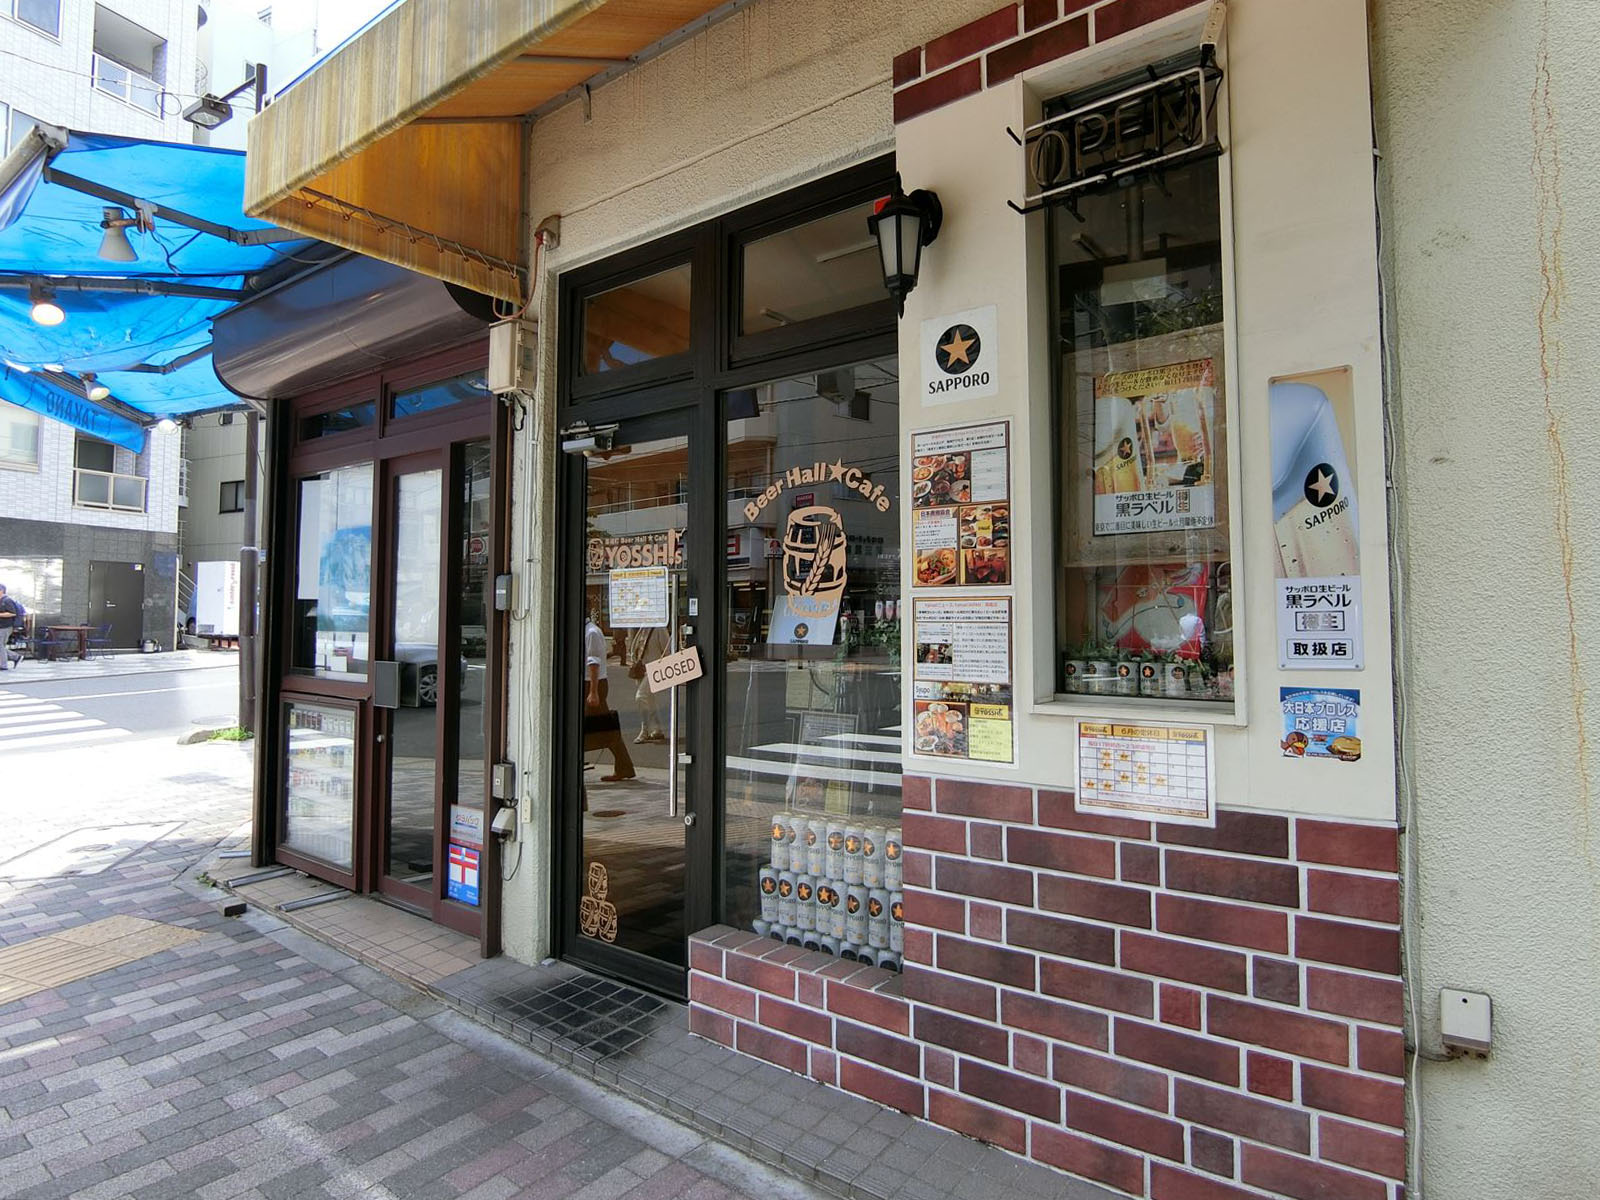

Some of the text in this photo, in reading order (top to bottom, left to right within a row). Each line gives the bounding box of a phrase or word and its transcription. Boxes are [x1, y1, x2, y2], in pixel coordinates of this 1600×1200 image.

[1030, 75, 1197, 187] OPEN
[928, 371, 990, 394] SAPPORO
[744, 462, 890, 522] Beer Hall Cafe
[1115, 500, 1175, 517] 黒ラベル
[1304, 496, 1350, 530] SAPPORO
[1285, 584, 1351, 594] サッポロ生ビール
[1286, 594, 1352, 609] 黒ラベル
[1293, 641, 1347, 656] 取扱店
[652, 658, 696, 683] CLOSED
[1284, 701, 1357, 718] 大日本プロレス
[1295, 717, 1346, 733] 応援店
